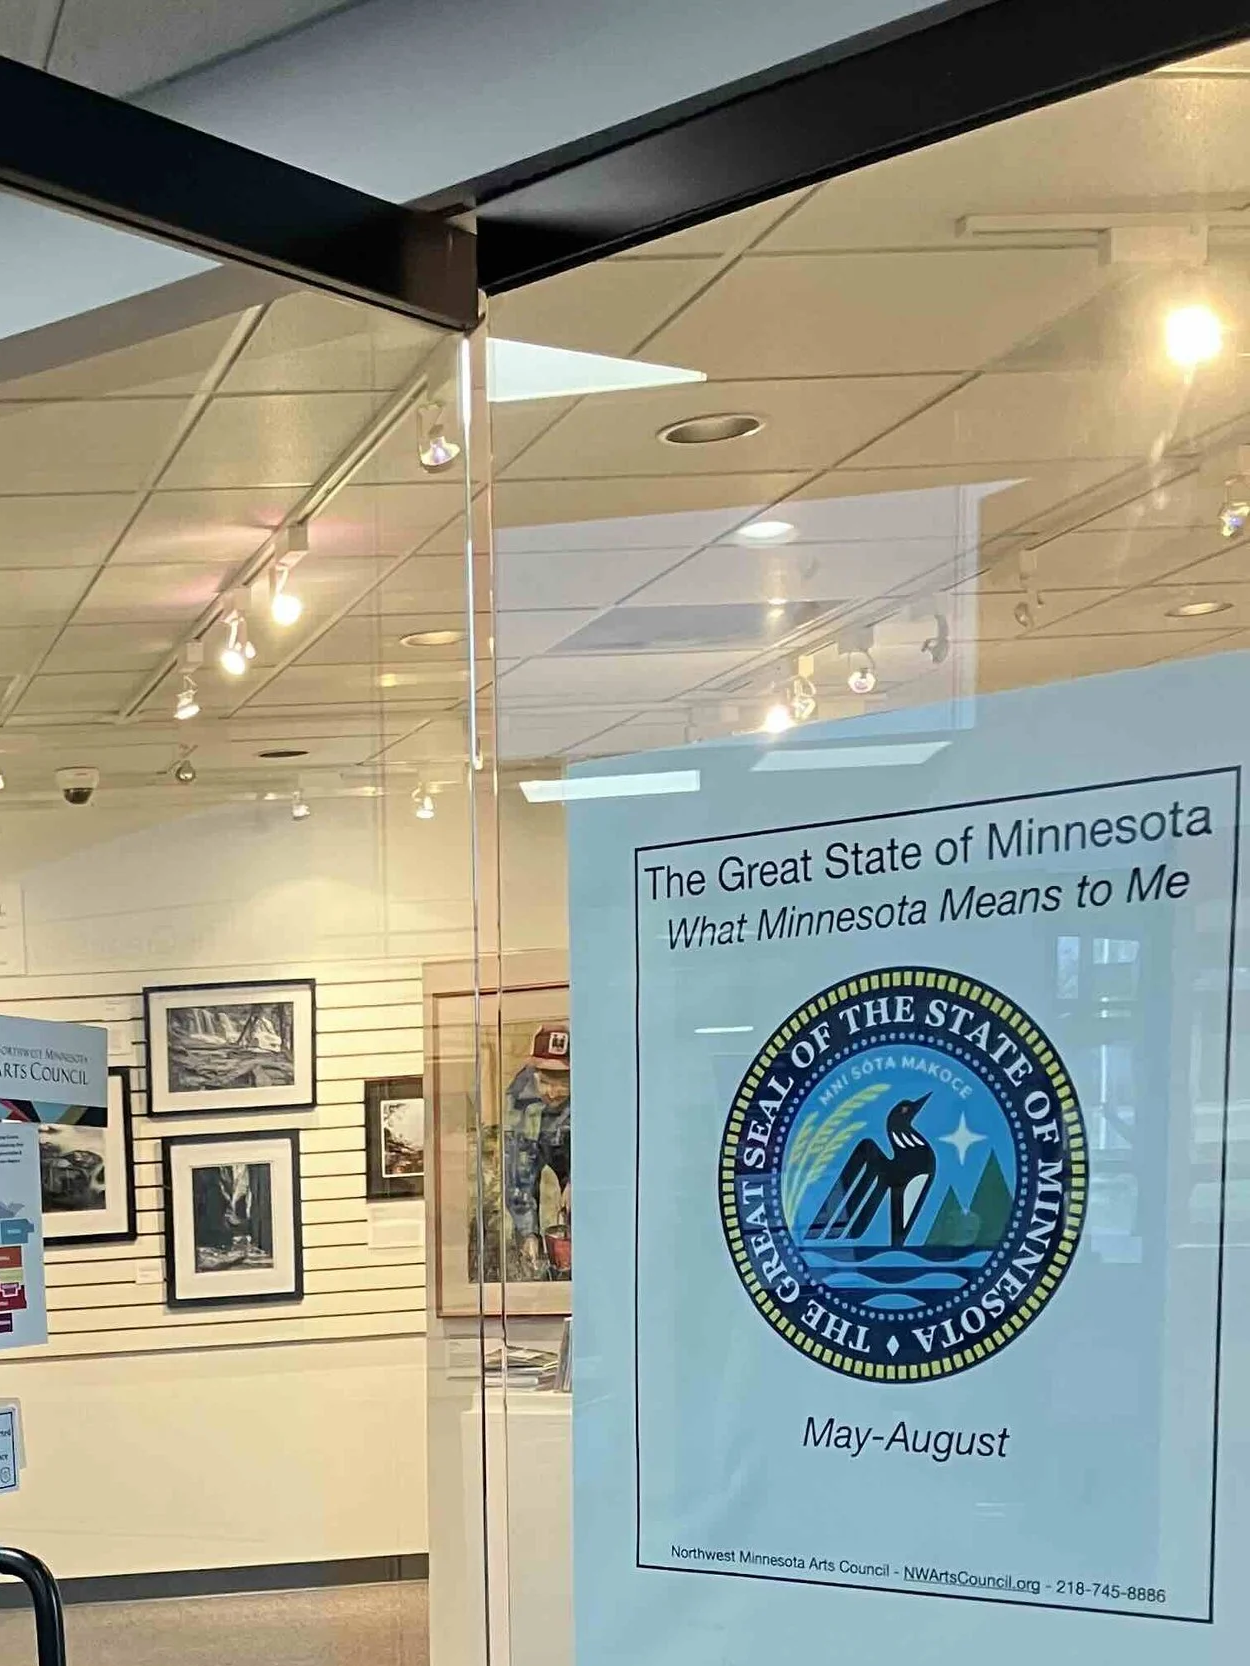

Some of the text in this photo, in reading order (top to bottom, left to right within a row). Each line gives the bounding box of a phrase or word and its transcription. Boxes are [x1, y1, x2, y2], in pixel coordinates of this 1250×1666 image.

[644, 800, 1213, 901] The Great State of Minnesota
[667, 863, 1191, 950] What Minnesota Means to Me
[818, 1074, 849, 1107] MNI
[901, 1055, 973, 1099] MAKOCE
[742, 996, 1064, 1355] THE GREAT SEAL OF THE STATE OF MINNESOTA
[803, 1416, 1010, 1463] May-August
[671, 1545, 735, 1563] Northwest
[739, 1551, 805, 1569] Minnesota
[809, 1557, 835, 1572] Arts
[839, 1560, 890, 1578] Council
[904, 1566, 1040, 1594] NWArtsCouncil.org
[1056, 1579, 1166, 1603] 218-745-8886
